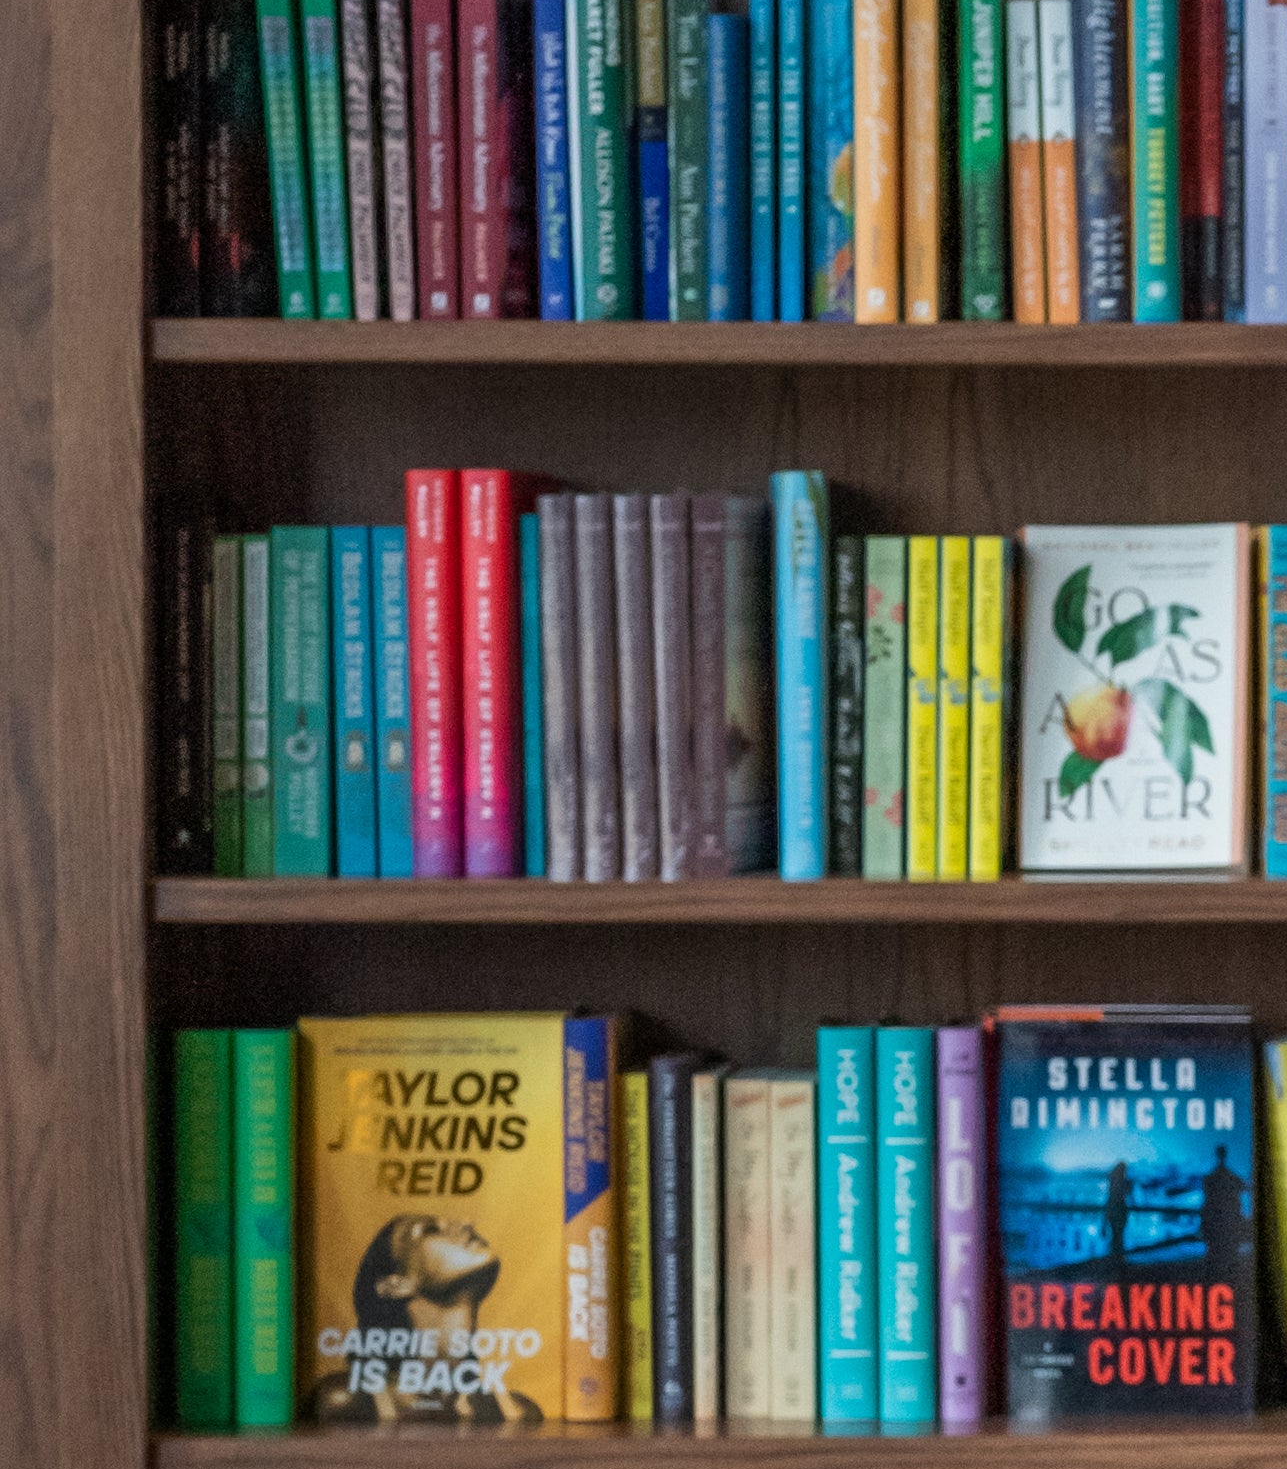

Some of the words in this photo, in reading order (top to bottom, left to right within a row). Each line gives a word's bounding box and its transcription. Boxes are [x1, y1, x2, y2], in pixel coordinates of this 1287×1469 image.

[1156, 638, 1222, 683] AS
[1043, 774, 1213, 823] RIVER
[836, 1049, 860, 1124] HOPE
[1048, 1057, 1196, 1091] STELLA
[1010, 1097, 1235, 1131] RIMINGTON
[377, 1159, 483, 1195] REID
[1009, 1283, 1235, 1331] BREAKING
[317, 1327, 441, 1359] CARRIE
[449, 1327, 542, 1359] SOTO
[1087, 1337, 1236, 1385] COVER
[349, 1358, 387, 1394] IS
[397, 1358, 512, 1395] BACK
